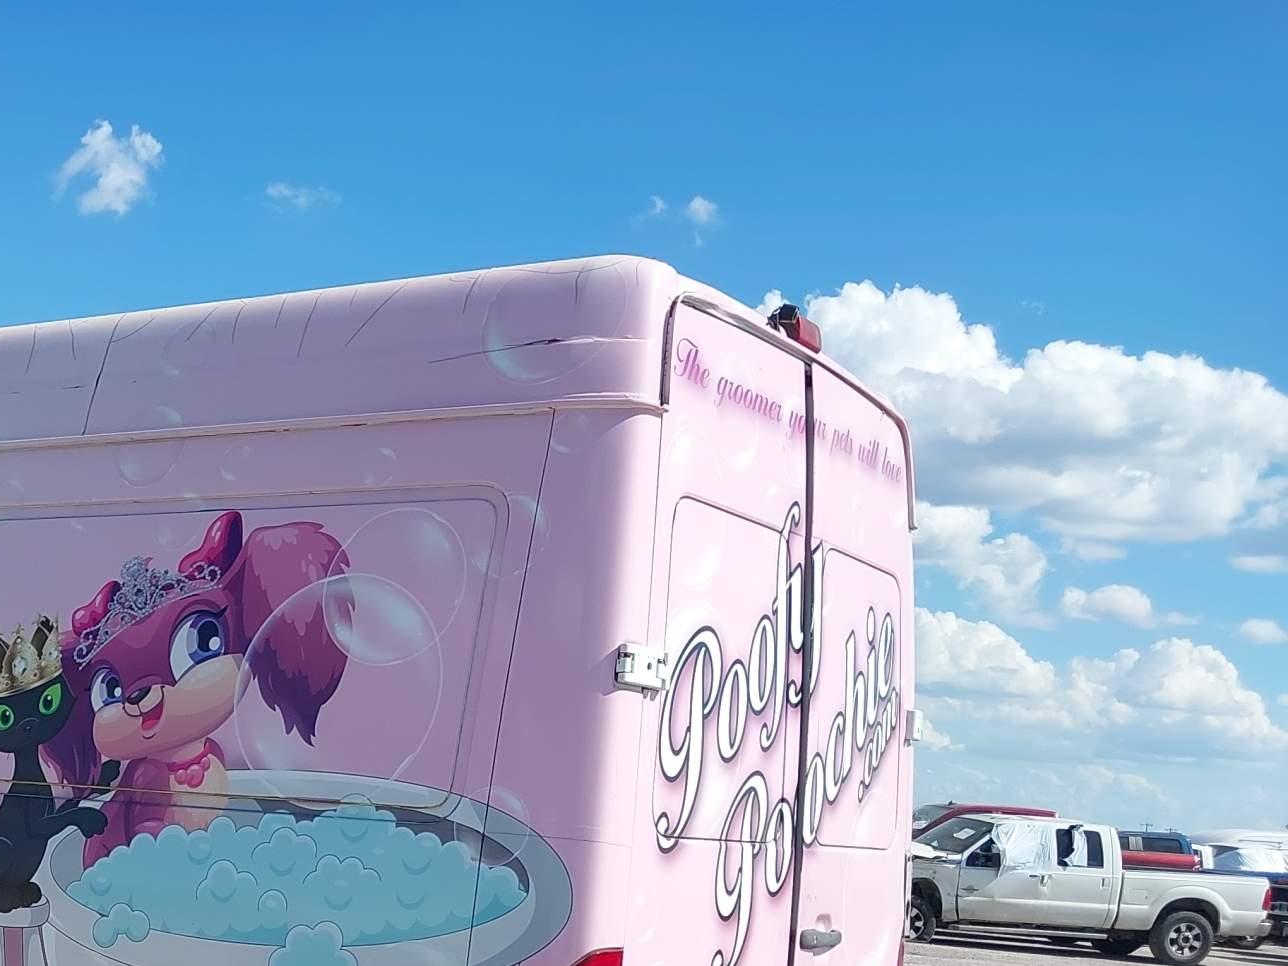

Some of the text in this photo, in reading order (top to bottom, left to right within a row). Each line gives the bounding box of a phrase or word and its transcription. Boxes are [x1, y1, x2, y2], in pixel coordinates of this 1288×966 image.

[673, 338, 711, 389] The
[714, 375, 782, 425] groomer
[829, 428, 853, 456] pets
[858, 440, 880, 470] will
[881, 447, 902, 482] love
[655, 501, 823, 854] Poofy
